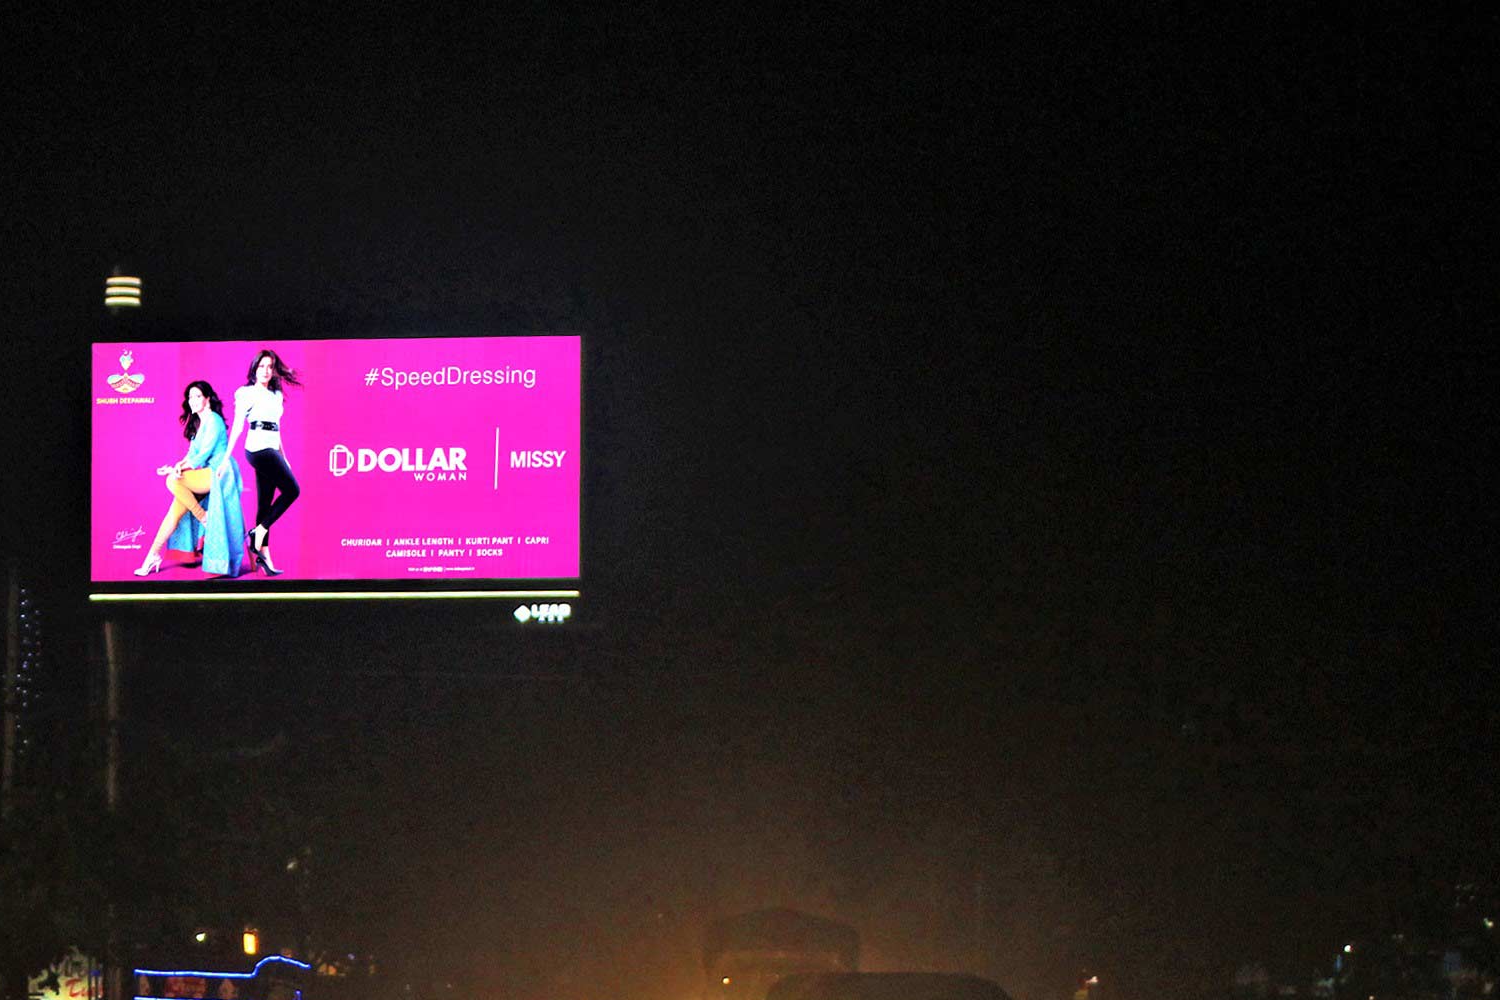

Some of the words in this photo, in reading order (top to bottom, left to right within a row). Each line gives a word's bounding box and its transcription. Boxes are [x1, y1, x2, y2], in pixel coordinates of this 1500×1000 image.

[364, 365, 536, 390] #SpeedDressing
[357, 447, 468, 472] DOLLAR
[509, 450, 567, 468] MISSY
[413, 472, 467, 482] WOMAN
[340, 538, 383, 546] CHURIDAR
[393, 538, 420, 546] ANKLE
[421, 538, 454, 546] LENGTH
[465, 537, 490, 545] KURTI
[491, 537, 514, 545] PANT
[524, 537, 550, 545] CAPRI
[385, 550, 427, 558] CAMISOLE
[438, 549, 465, 557] PANTY
[476, 549, 503, 557] SOCKS
